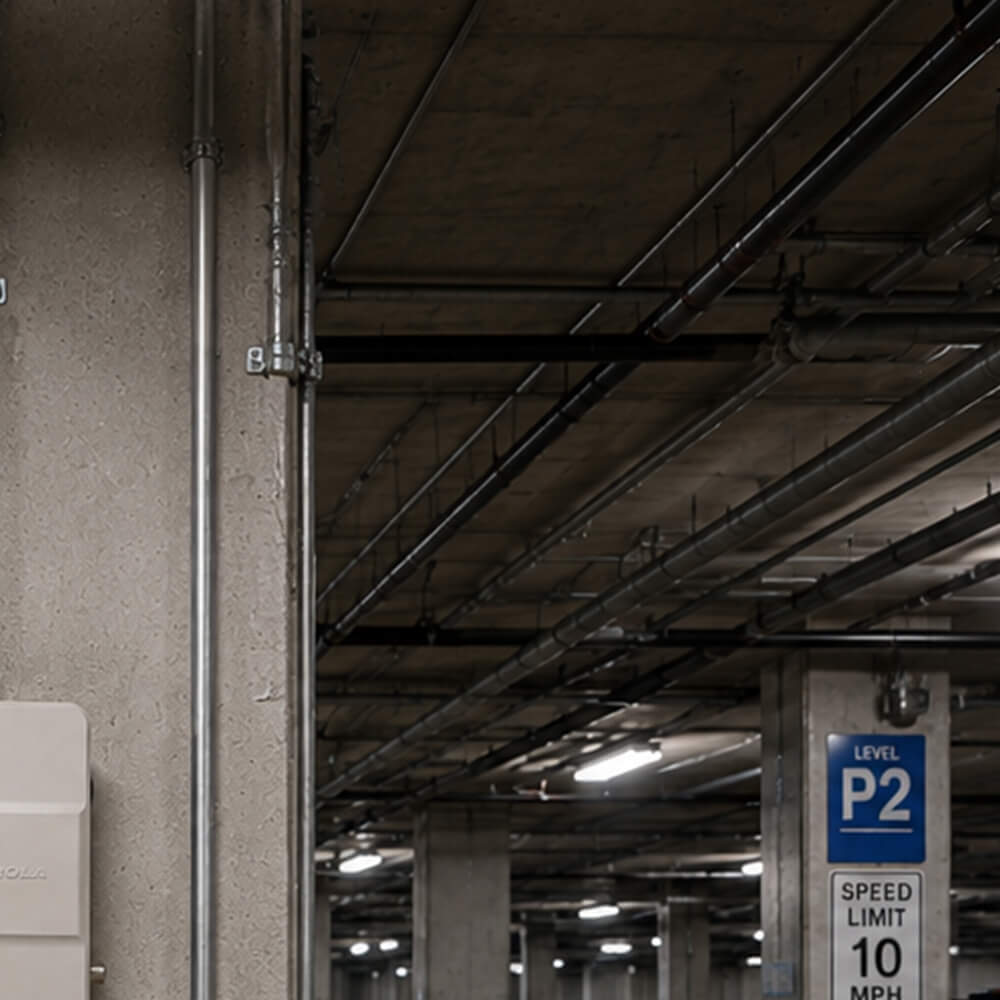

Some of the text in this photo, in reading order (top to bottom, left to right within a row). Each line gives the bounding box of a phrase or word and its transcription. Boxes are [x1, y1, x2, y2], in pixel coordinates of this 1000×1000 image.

[854, 745, 900, 761] LEVEL
[842, 767, 912, 821] P2
[841, 882, 913, 901] SPEED
[848, 907, 906, 927] LIMIT
[852, 936, 902, 978] 10
